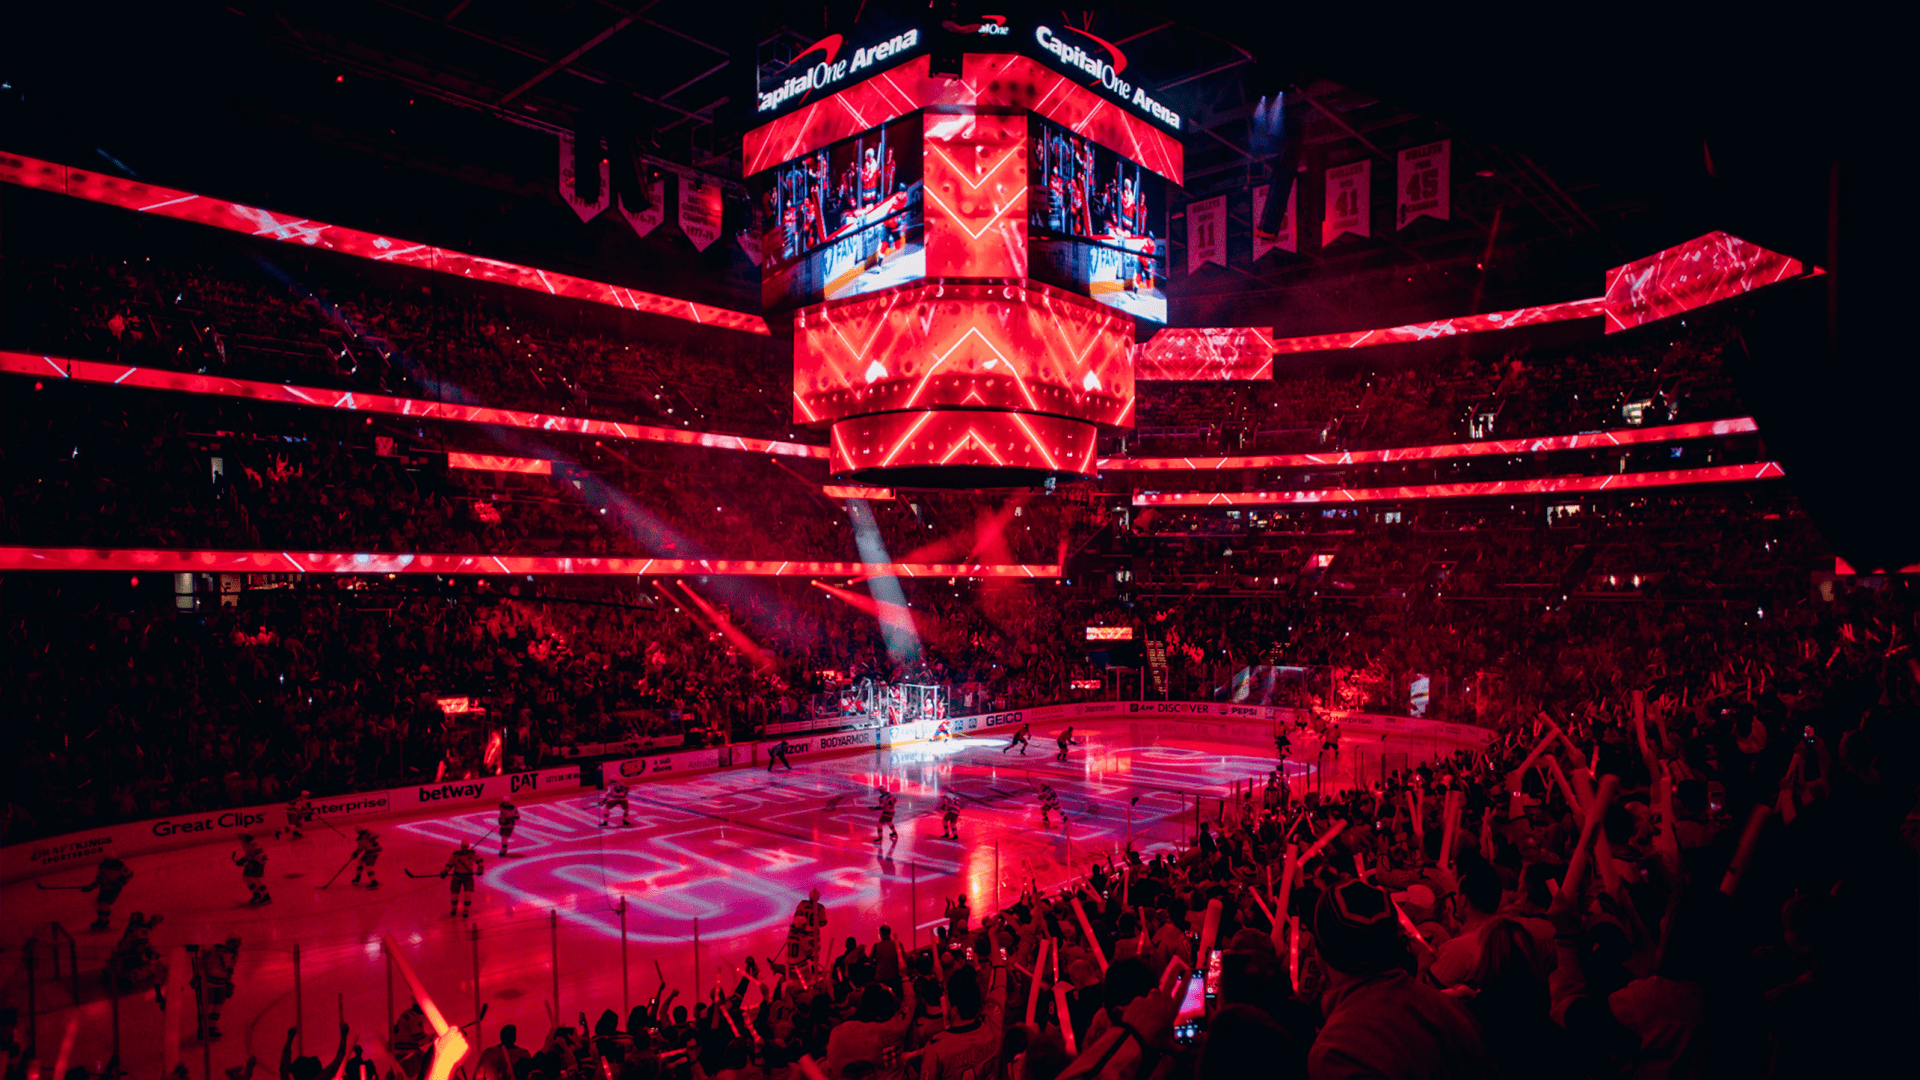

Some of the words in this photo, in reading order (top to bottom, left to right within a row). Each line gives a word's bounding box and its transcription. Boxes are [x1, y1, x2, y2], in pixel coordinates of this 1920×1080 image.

[850, 28, 918, 73] Arena
[1132, 87, 1181, 129] Arena
[1406, 168, 1438, 201] 45
[1335, 188, 1359, 217] 41
[1197, 221, 1215, 249] 11
[1031, 706, 1064, 716] HONDA
[1158, 704, 1208, 713] DISCOVER
[1232, 707, 1257, 716] PEPSI
[986, 712, 1022, 727] GEICO
[820, 733, 870, 749] BODYARMOR
[419, 782, 485, 802] betway
[510, 773, 538, 793] CAT
[310, 796, 388, 816] nterprise
[152, 816, 213, 837] Great
[217, 812, 265, 831] Clips
[30, 836, 112, 861] DRAFTKINGS
[42, 846, 104, 864] SPORTSBOOK
